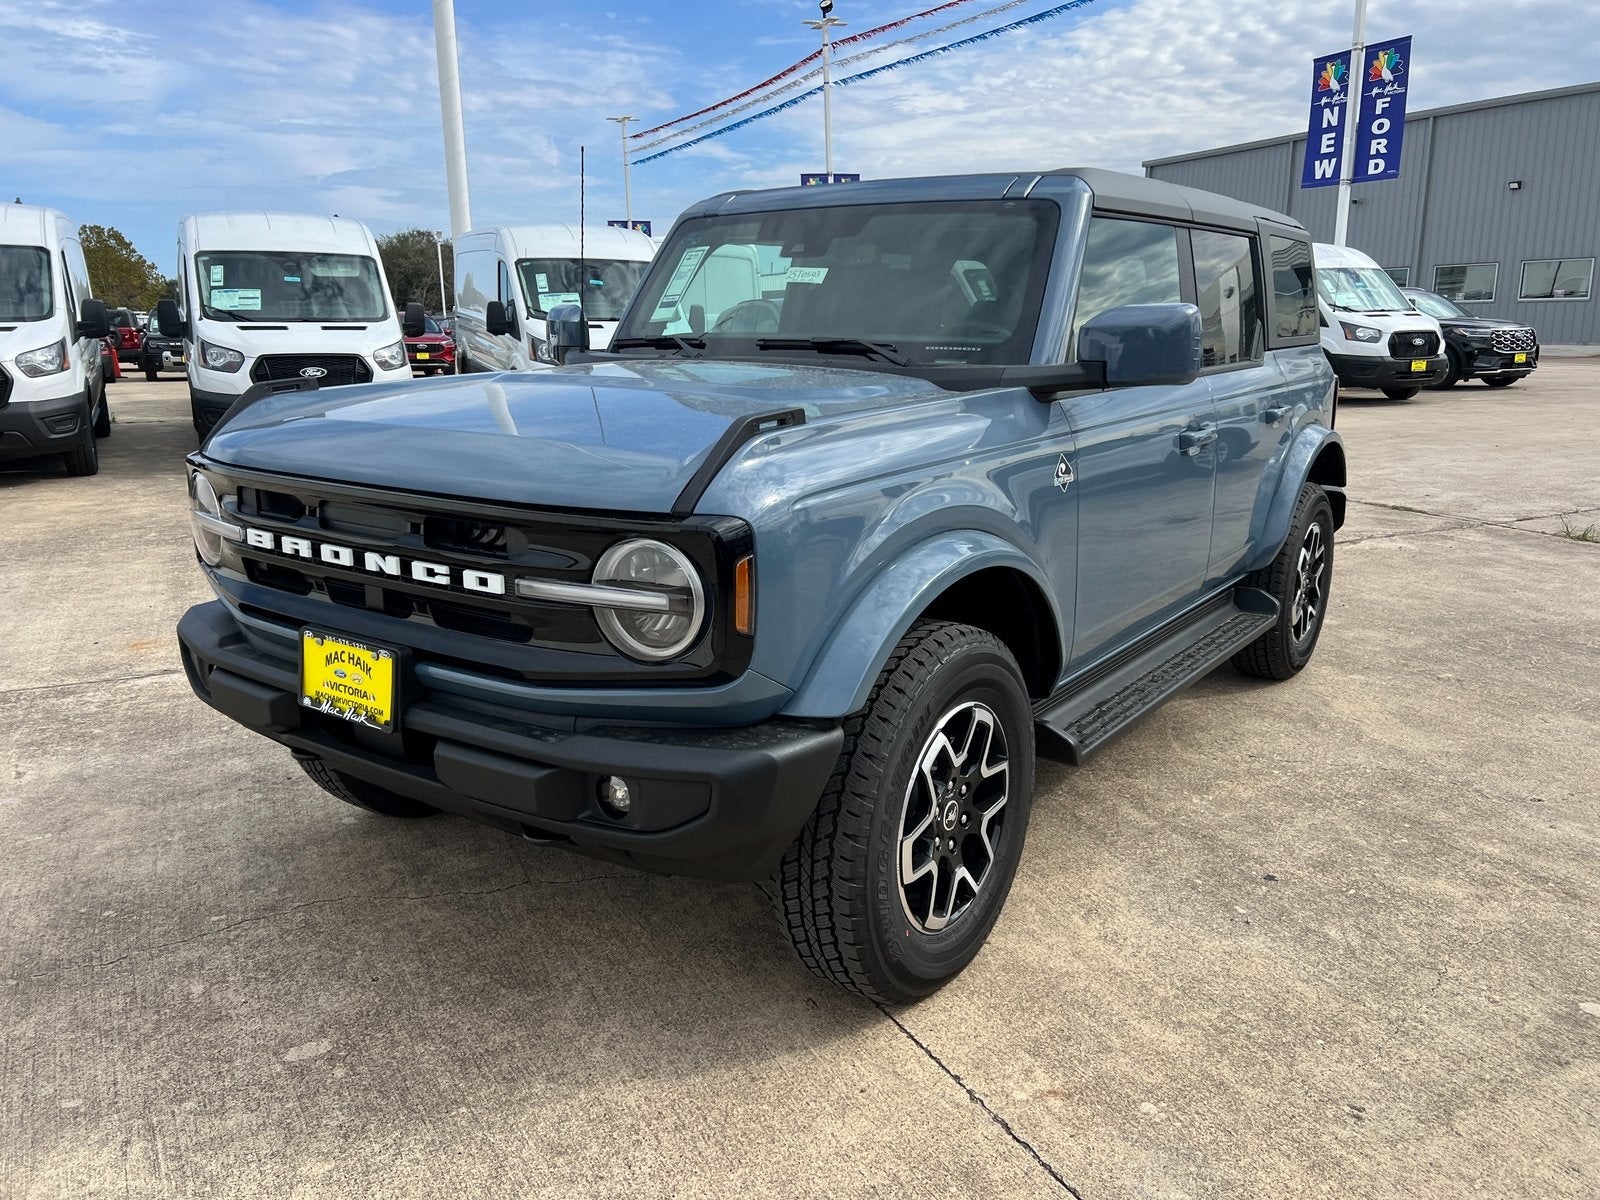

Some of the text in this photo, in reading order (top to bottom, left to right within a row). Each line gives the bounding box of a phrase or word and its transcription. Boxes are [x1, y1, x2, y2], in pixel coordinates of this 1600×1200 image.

[1314, 106, 1340, 180] NEW
[1367, 97, 1391, 175] FORD
[246, 528, 506, 595] BRONCO
[325, 650, 346, 667] MAC
[347, 651, 372, 680] HAIK
[316, 700, 374, 726] Mac Haik
[329, 680, 369, 700] VICTORIA
